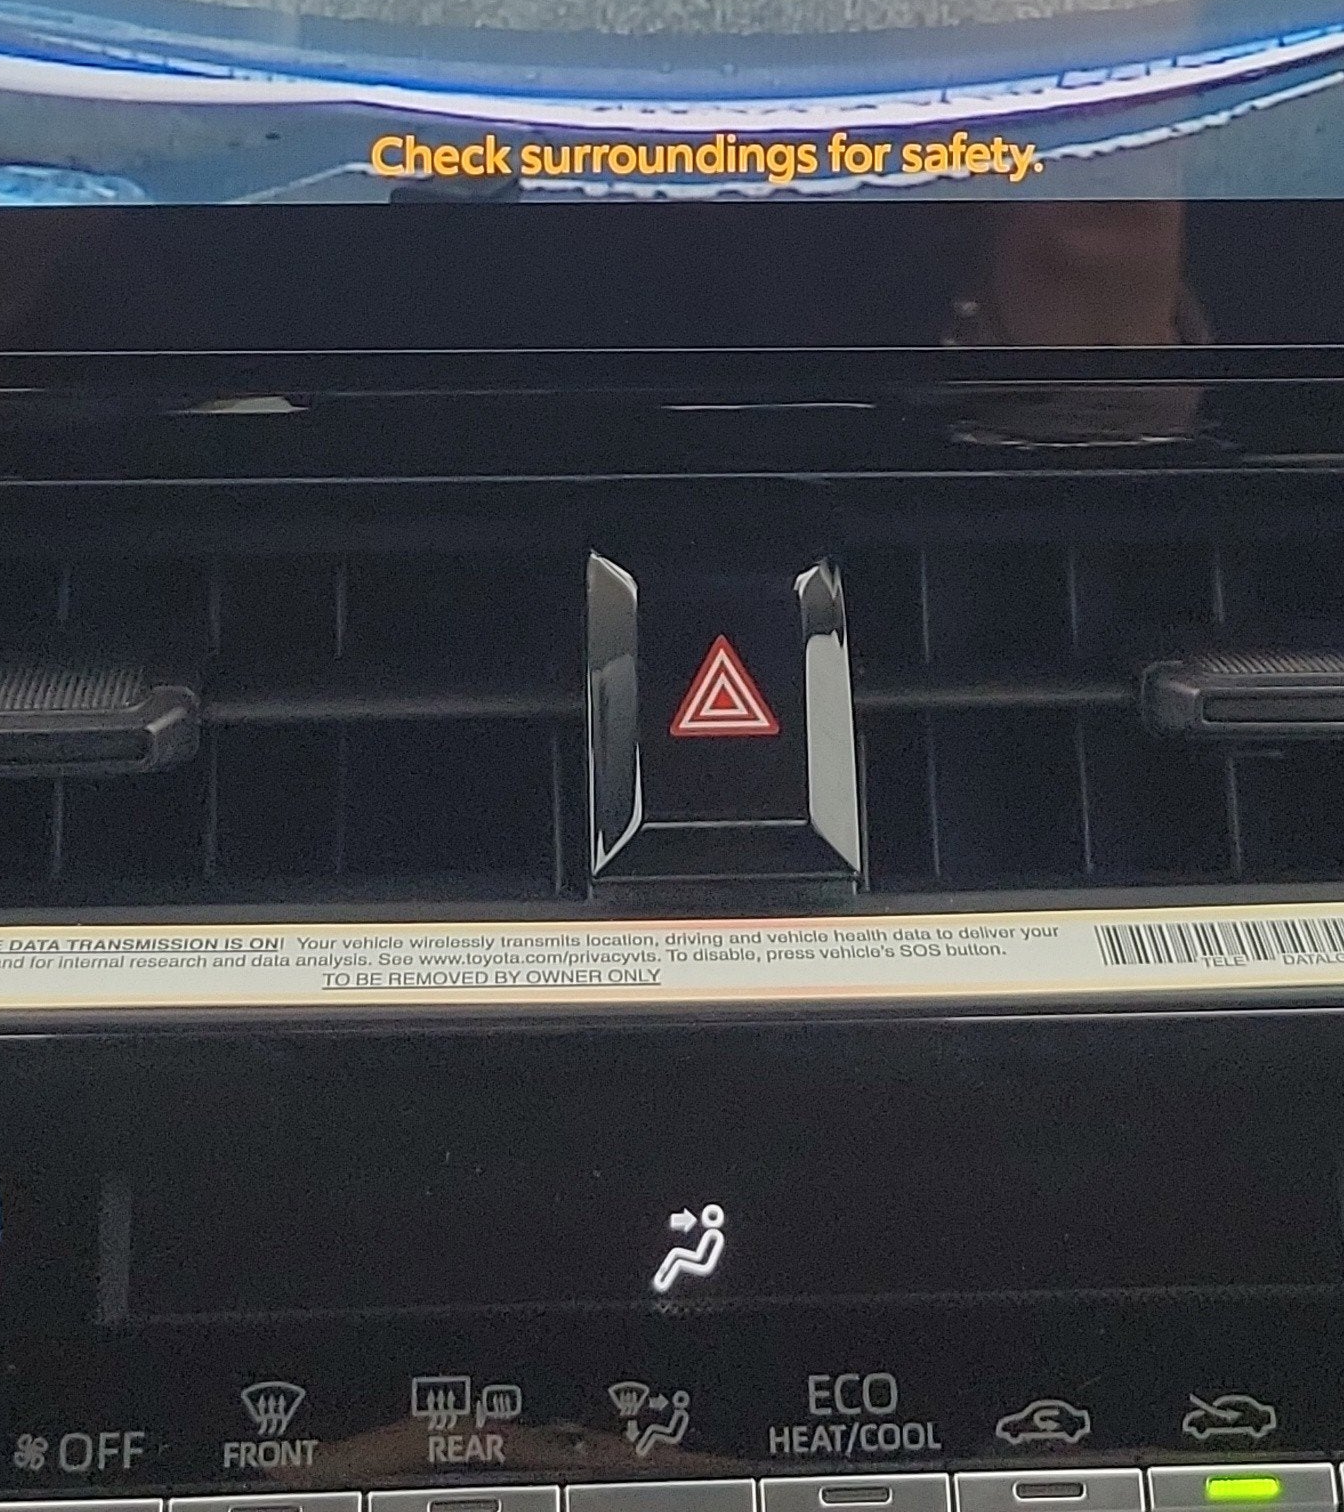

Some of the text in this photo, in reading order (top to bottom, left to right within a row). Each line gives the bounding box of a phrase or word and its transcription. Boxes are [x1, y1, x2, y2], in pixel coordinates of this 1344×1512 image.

[371, 131, 1044, 184] Check surroundings for safety.
[8, 939, 60, 951] DATA
[66, 938, 219, 951] TRANSMISSION
[224, 937, 244, 950] IS
[249, 937, 285, 950] ON!
[297, 937, 338, 950] Your
[342, 936, 404, 949] vehicle
[409, 935, 494, 949] wirelessly
[501, 934, 581, 948] transmits
[586, 933, 659, 948] location,
[665, 932, 723, 948] driving
[729, 931, 762, 944] and
[766, 930, 829, 944] vehicle
[834, 929, 887, 942] health
[892, 928, 931, 942] data
[936, 928, 953, 940] to
[958, 926, 1016, 940] deliver
[1020, 926, 1059, 940] your
[29, 955, 53, 969] for
[58, 955, 125, 969] internal
[129, 955, 207, 968] research
[212, 954, 246, 968] and
[251, 954, 290, 967] data
[295, 953, 372, 969] analysis.
[378, 953, 413, 966] See
[666, 948, 688, 962] To
[693, 947, 761, 963] disable,
[766, 948, 815, 963] press
[820, 944, 895, 959] vehicle's
[900, 944, 941, 957] SOS
[946, 942, 1007, 957] button.
[1201, 955, 1246, 968] TELE
[322, 968, 661, 986] TO BE REMOVED BY OWNER ONLY
[806, 1372, 899, 1415] ECO
[58, 1430, 146, 1472] OFF
[222, 1438, 320, 1468] FRONT
[427, 1433, 505, 1464] REAR
[769, 1421, 942, 1457] HEAT/COOL
